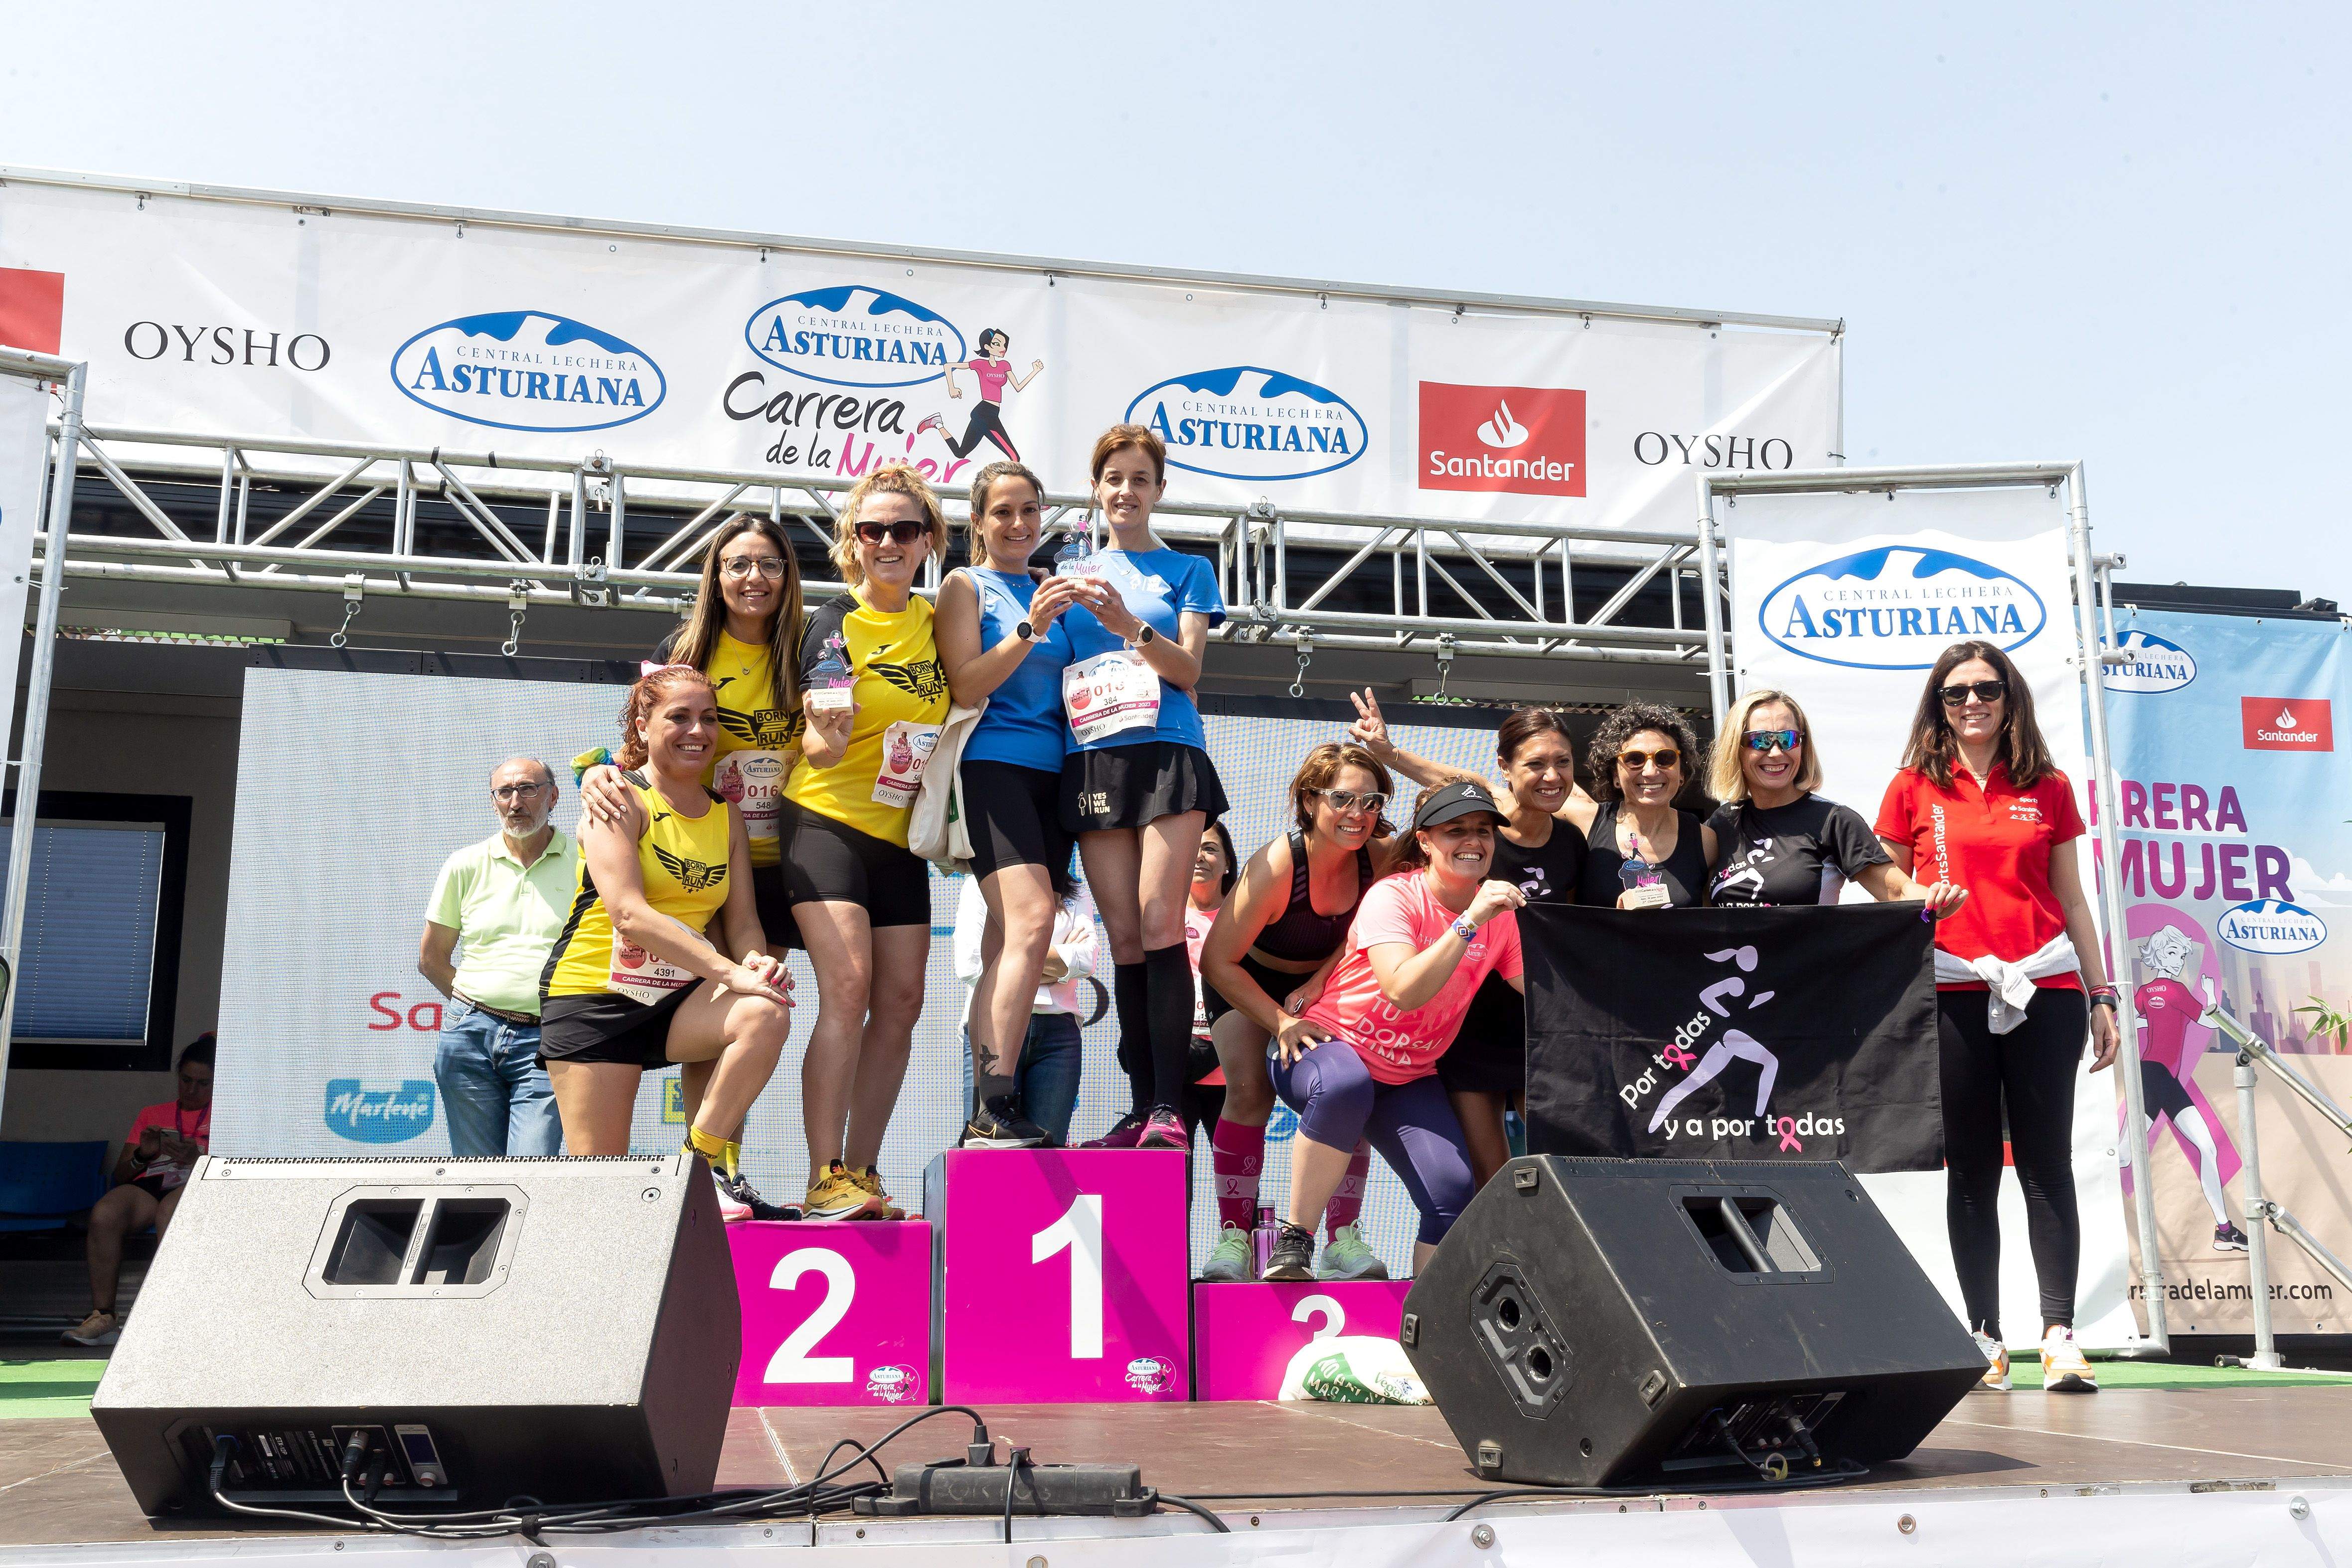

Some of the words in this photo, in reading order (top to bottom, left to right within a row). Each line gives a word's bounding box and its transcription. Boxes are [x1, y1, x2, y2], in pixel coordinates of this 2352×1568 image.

[798, 315, 866, 331] CENTRAL
[874, 323, 943, 337] LECHERA
[125, 321, 330, 371] OYSHO
[762, 314, 948, 366] ASTURIANA
[457, 346, 542, 364] CENTRAL
[553, 355, 638, 371] LECHERA
[411, 346, 646, 407] ASTURIANA
[723, 371, 906, 435] Carrera
[1183, 401, 1257, 416] CENTRAL
[1266, 407, 1343, 421] LECHERA
[1149, 401, 1351, 455] ASTURIANA
[766, 429, 799, 465] de
[808, 432, 831, 468] la
[1634, 432, 1793, 470] OYSHO
[1430, 451, 1575, 482] Santander
[1824, 589, 1912, 601] CENTRAL
[1923, 586, 2013, 599] LECHERA
[1782, 595, 2027, 639] ASTURIANA
[910, 662, 933, 675] BORN
[919, 680, 941, 694] RUN
[1103, 696, 1117, 706] 384
[758, 711, 789, 722] BORN
[1079, 712, 1103, 723] CARRERA
[1081, 723, 1105, 736] OYSHO
[2257, 729, 2318, 742] Santander
[760, 732, 789, 744] RUN
[748, 785, 779, 797] 016
[886, 780, 908, 789] CARRERA
[878, 789, 904, 802] OYSHO
[1931, 803, 1951, 886] ortsSantander
[686, 861, 705, 872] BORN
[684, 876, 704, 887] RUN
[2226, 918, 2320, 941] ASTURIANA
[654, 968, 675, 977] 4391
[623, 976, 651, 985] CARRERA
[618, 987, 649, 999] OYSHO
[2147, 985, 2167, 993] OYSHO
[1372, 995, 1402, 1021] TU
[1619, 1067, 1658, 1109] Por
[1665, 1119, 1679, 1141] y
[1686, 1120, 1703, 1136] a
[1712, 1117, 1755, 1141] por
[1032, 1195, 1103, 1359] 1
[763, 1247, 856, 1384] 2
[1125, 1373, 1152, 1382] Carrera
[866, 1381, 895, 1391] Carrera
[1140, 1380, 1162, 1395] Mujer
[882, 1389, 905, 1404] Mujer
